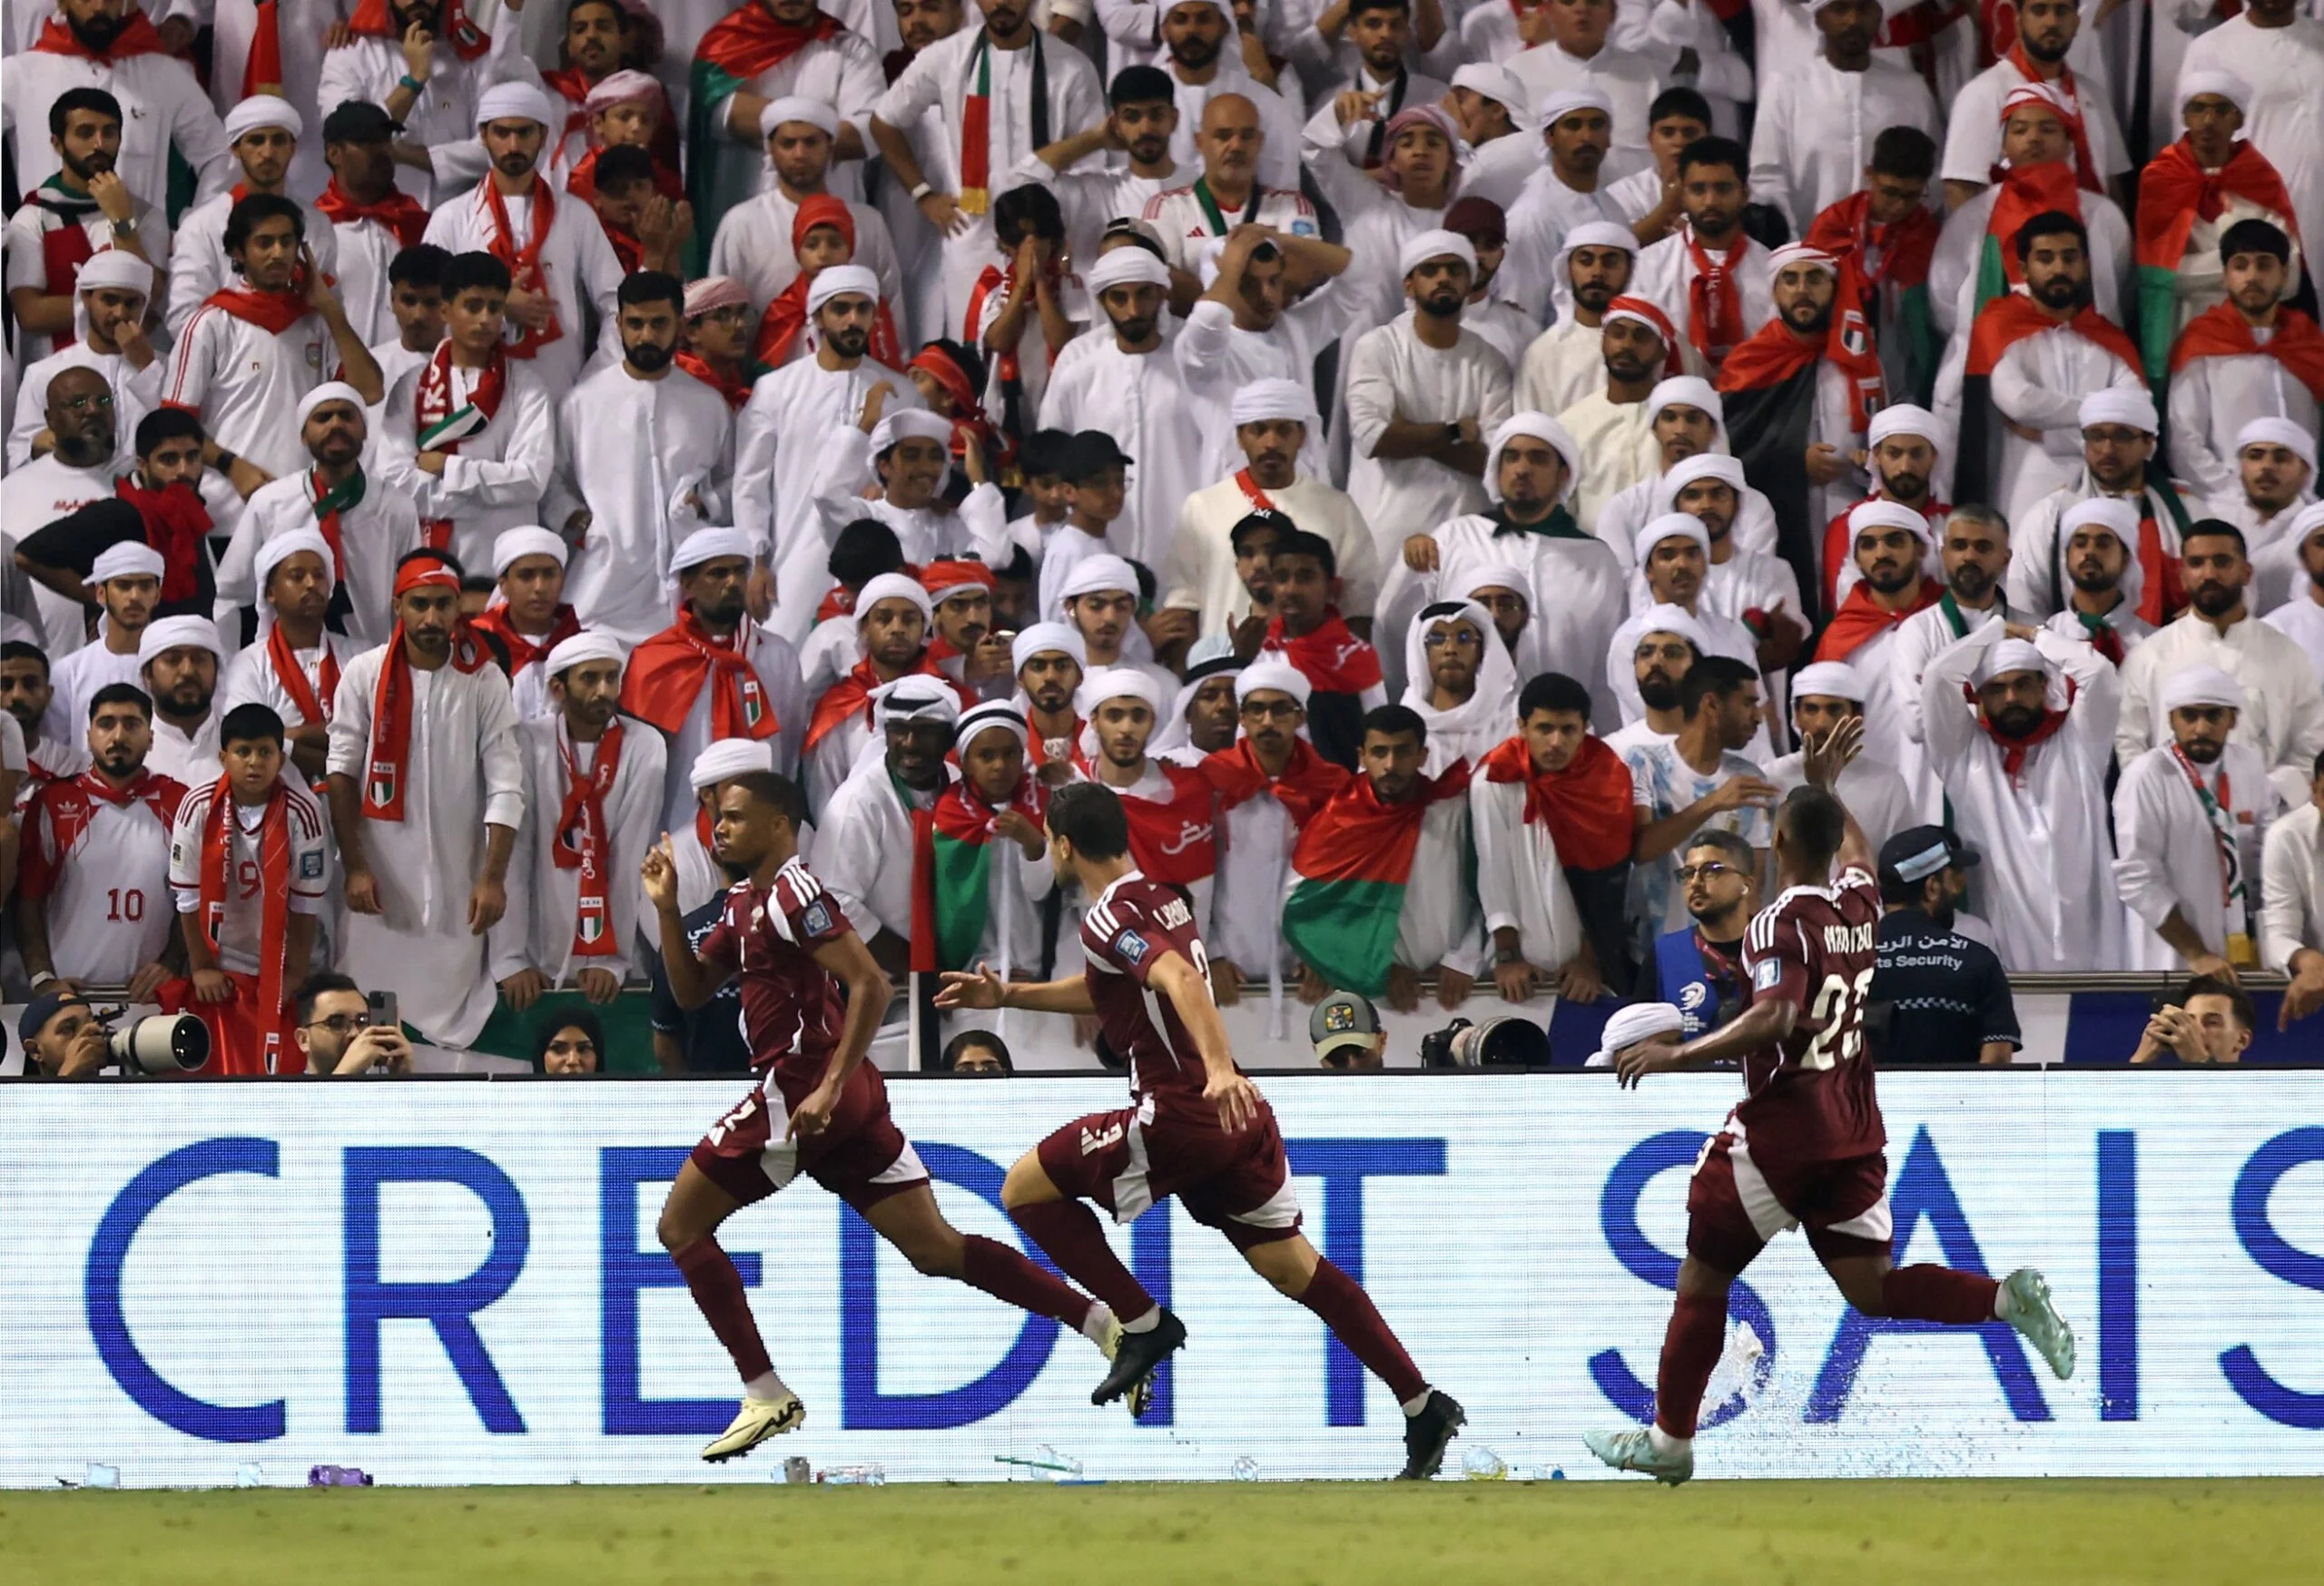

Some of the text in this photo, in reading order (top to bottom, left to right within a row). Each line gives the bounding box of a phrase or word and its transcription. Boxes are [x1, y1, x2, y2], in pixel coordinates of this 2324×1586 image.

[106, 888, 145, 923] 10
[1875, 934, 1913, 953] الري
[1896, 954, 1963, 971] Security
[84, 1135, 1447, 1443] CREDIT
